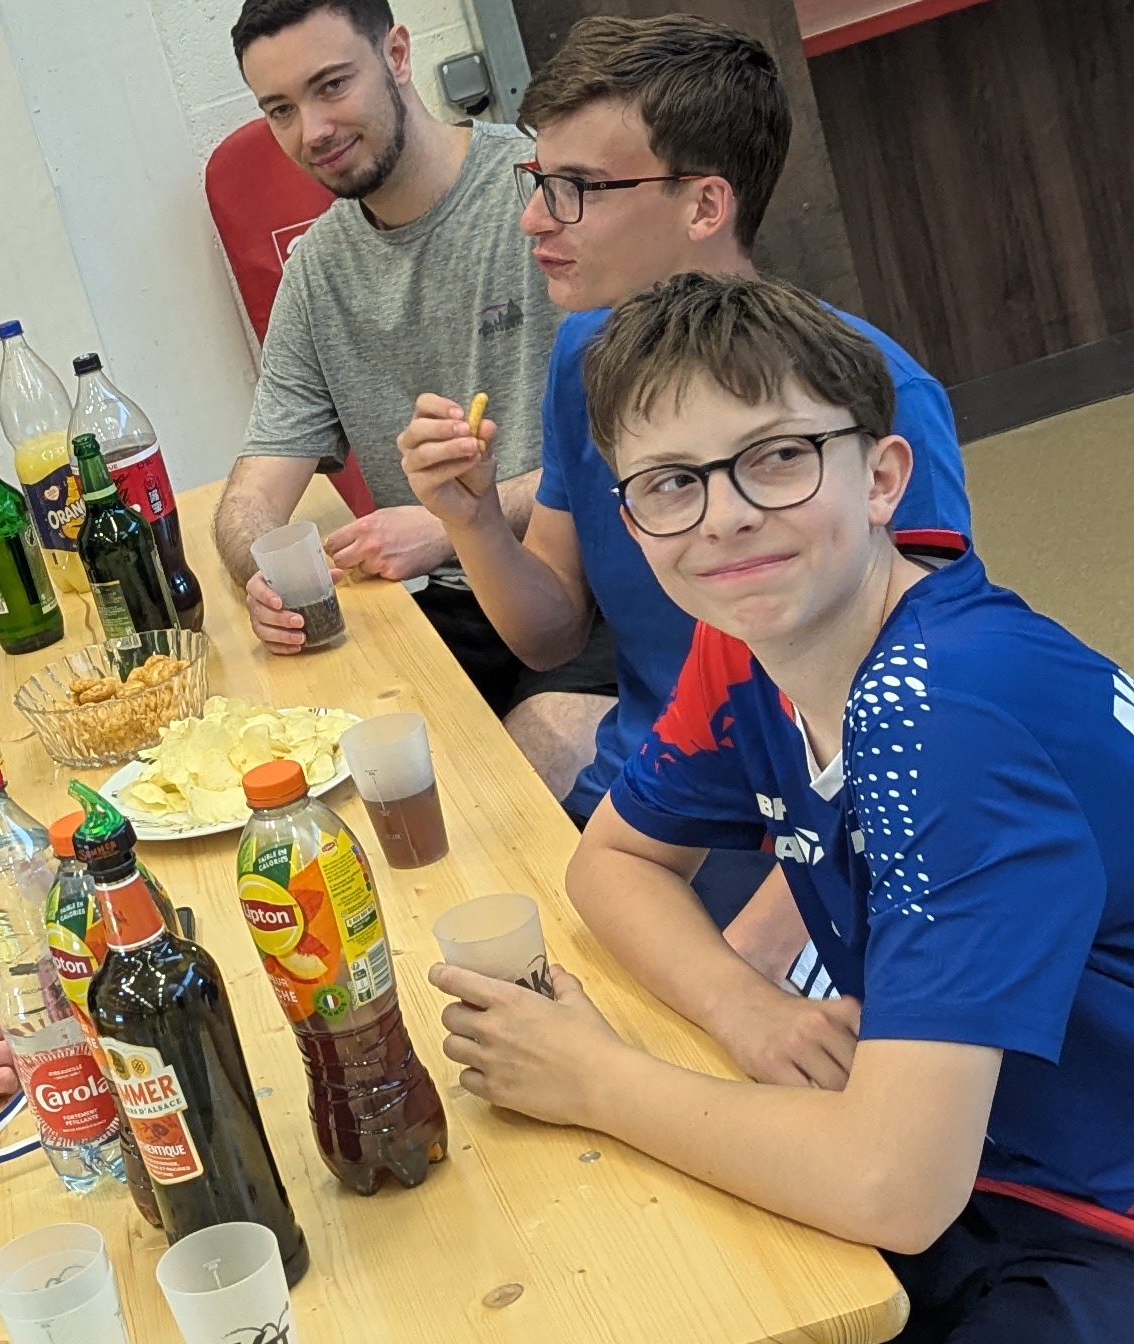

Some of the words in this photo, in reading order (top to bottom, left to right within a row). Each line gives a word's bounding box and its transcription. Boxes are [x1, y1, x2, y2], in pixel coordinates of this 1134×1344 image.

[47, 498, 86, 531] ORAN
[242, 901, 291, 924] Lipton
[274, 987, 299, 1003] CHE
[35, 1074, 110, 1113] Carola
[117, 1074, 178, 1107] MMER
[139, 1096, 183, 1116] D'ALSACE
[143, 1144, 187, 1158] ENTIQUE
